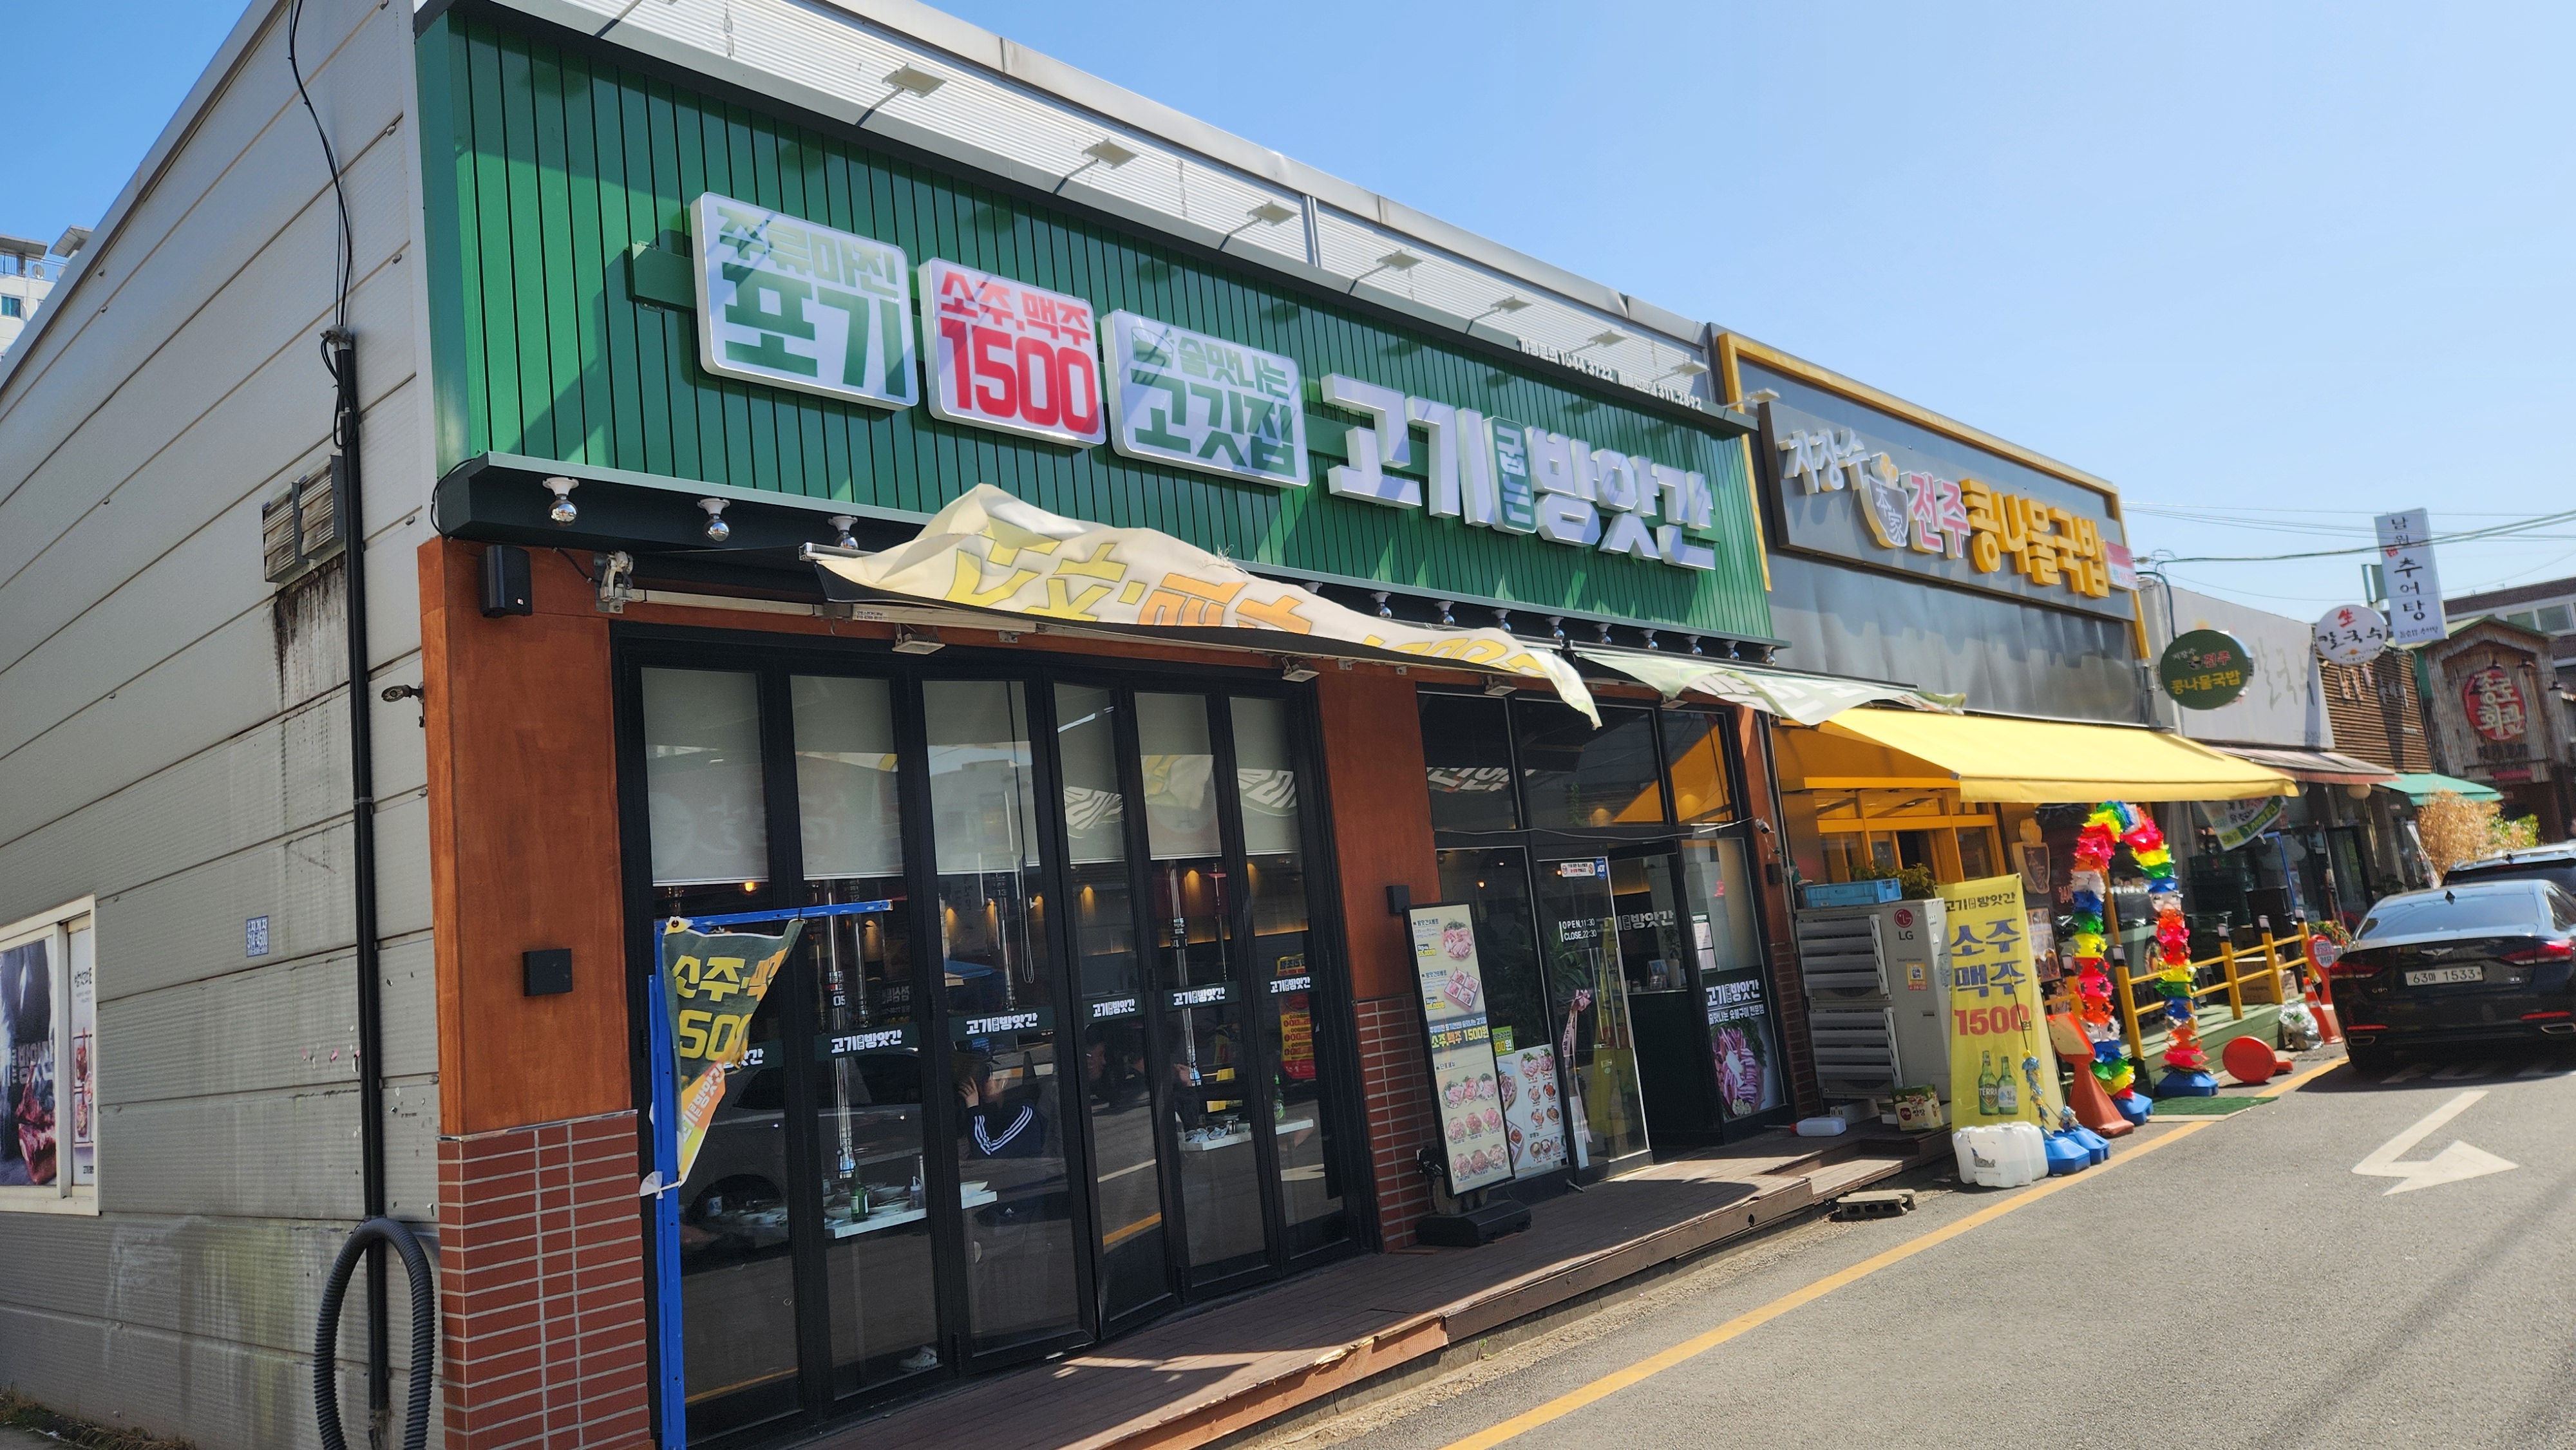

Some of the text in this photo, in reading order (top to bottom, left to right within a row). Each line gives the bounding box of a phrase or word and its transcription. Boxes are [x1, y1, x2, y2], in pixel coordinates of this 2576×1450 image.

[717, 205, 899, 302] 주류마진
[722, 262, 906, 399] 포기
[940, 317, 1099, 435] 1500
[1178, 337, 1287, 398] 술맛나는
[1130, 368, 1297, 477] 고깃집
[1321, 373, 1495, 527] 고기
[1525, 426, 1716, 571] 방앗간
[1778, 428, 1870, 494] 지장수
[1875, 484, 1904, 542] 本家
[1902, 471, 1971, 559] 전주
[1960, 478, 2109, 598] 콩나물국밥
[2394, 557, 2425, 621] 추어탕
[2338, 608, 2356, 628] 生
[2203, 650, 2231, 668] 전주
[2171, 670, 2240, 695] 콩나물국밥
[1631, 910, 1674, 928] 방앗간
[1945, 898, 1967, 912] 고기
[1977, 892, 2016, 907] 방앗간
[1899, 931, 1914, 940] LG
[1951, 918, 2022, 957] 소주
[1706, 984, 1726, 1006] 고기
[1730, 979, 1760, 1003] 방앗간
[1954, 960, 2026, 997] 맥주
[2413, 969, 2476, 984] 63마 1533
[1173, 992, 1191, 1006] 고기
[1198, 986, 1225, 1002] 방앗간
[831, 1035, 857, 1053] 고기
[864, 1029, 902, 1049] 방앗간
[966, 1017, 992, 1035] 고기
[999, 1012, 1037, 1030] 방앗간
